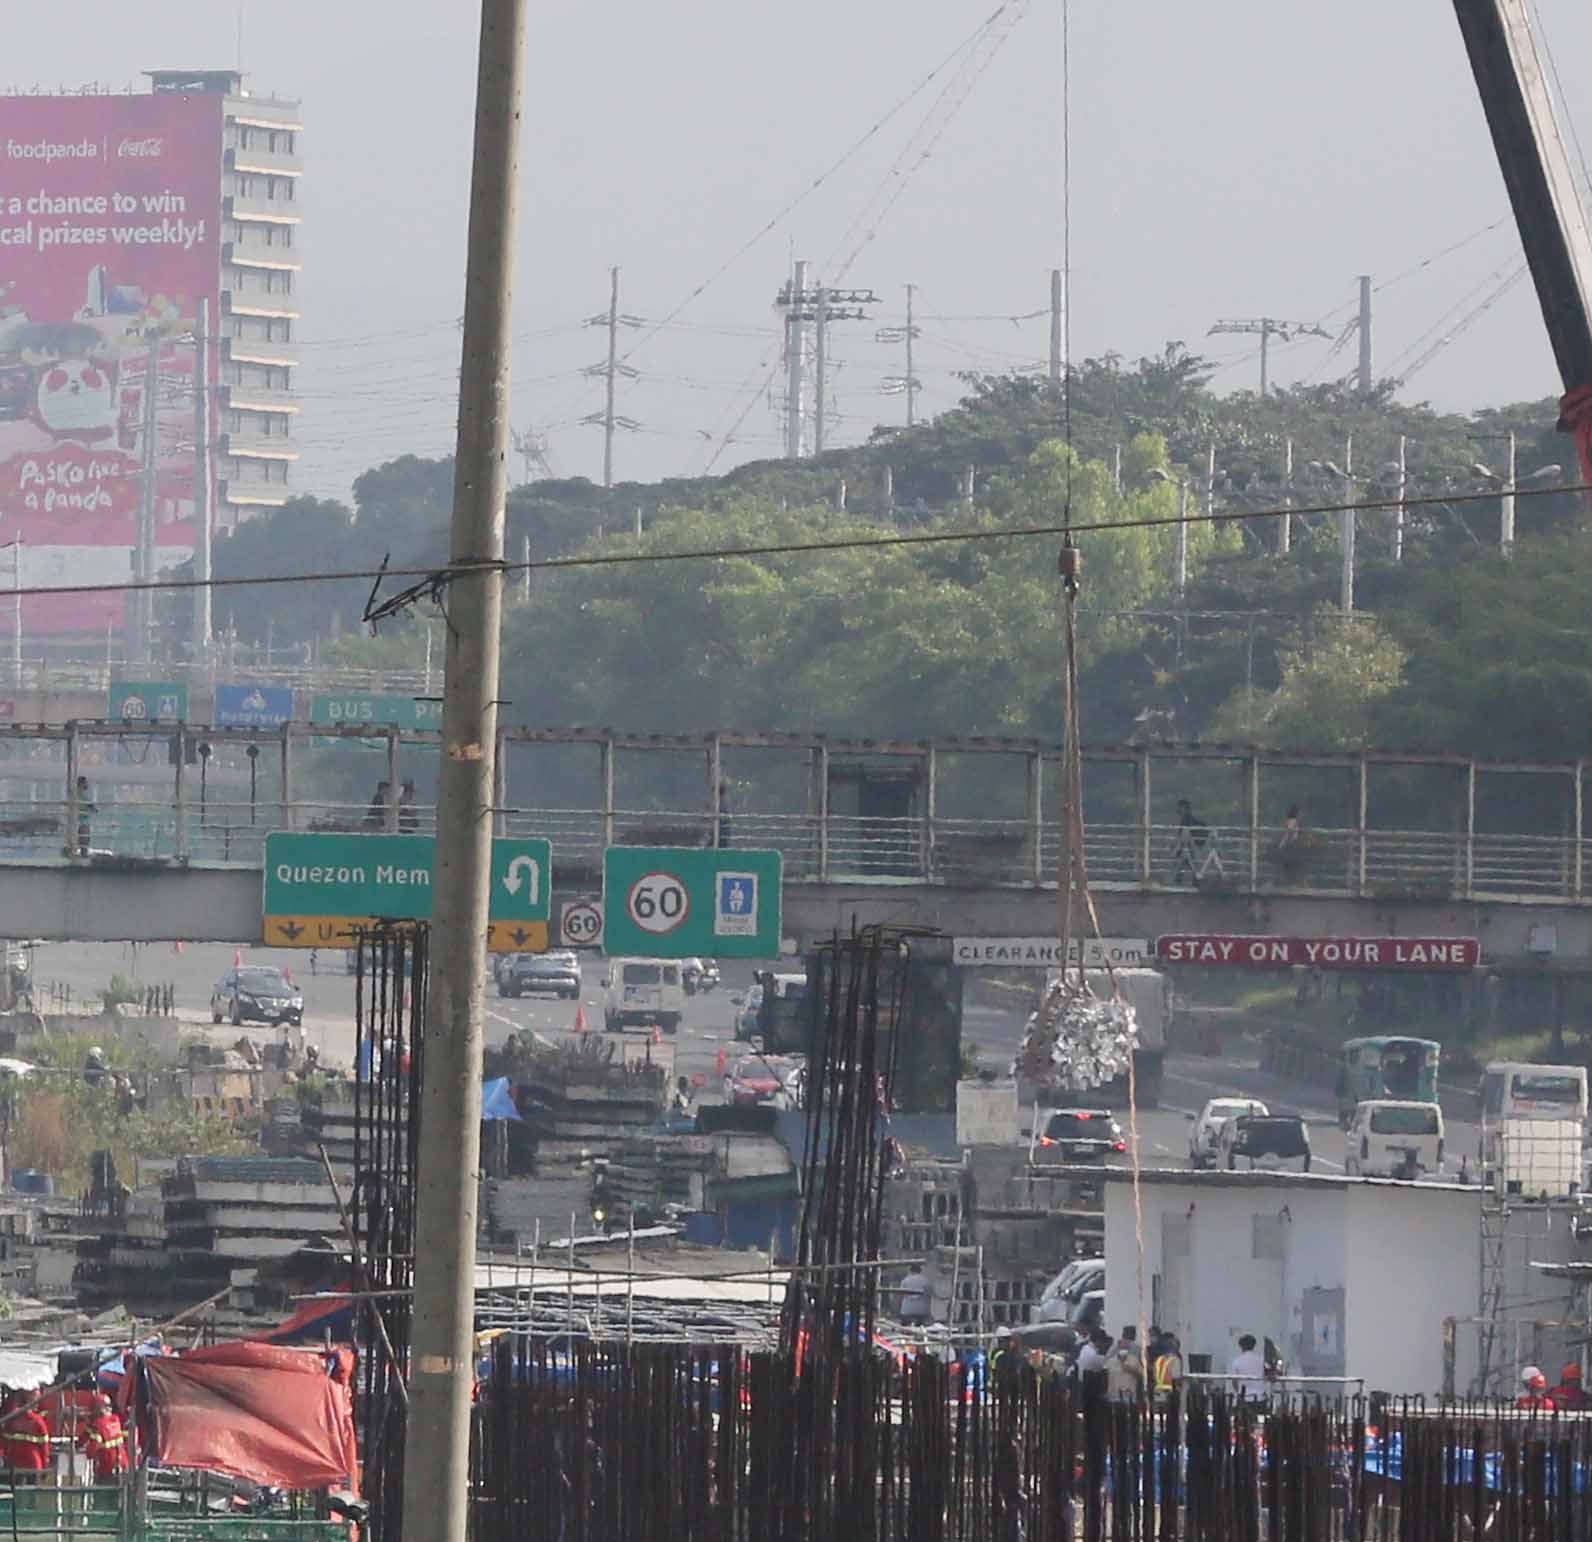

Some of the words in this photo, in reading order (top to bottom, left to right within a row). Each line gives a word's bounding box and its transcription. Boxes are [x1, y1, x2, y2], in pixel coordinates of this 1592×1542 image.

[7, 139, 97, 164] foodpanda
[8, 197, 21, 214] a
[26, 188, 106, 214] chance
[112, 191, 136, 213] to
[142, 189, 185, 213] win
[38, 221, 106, 251] prizes
[112, 219, 206, 250] weekly!
[25, 492, 38, 510] a
[328, 701, 373, 719] BUS
[277, 864, 365, 884] Quezon
[376, 865, 430, 885] Mem
[633, 886, 683, 919] 60
[568, 915, 597, 934] 60
[958, 945, 1078, 961] CLEARANCE
[1092, 945, 1142, 961] 50m
[1169, 942, 1233, 960] STAY
[1249, 943, 1288, 960] ON
[1306, 943, 1379, 962] YOUR
[1395, 944, 1465, 963] LANE
